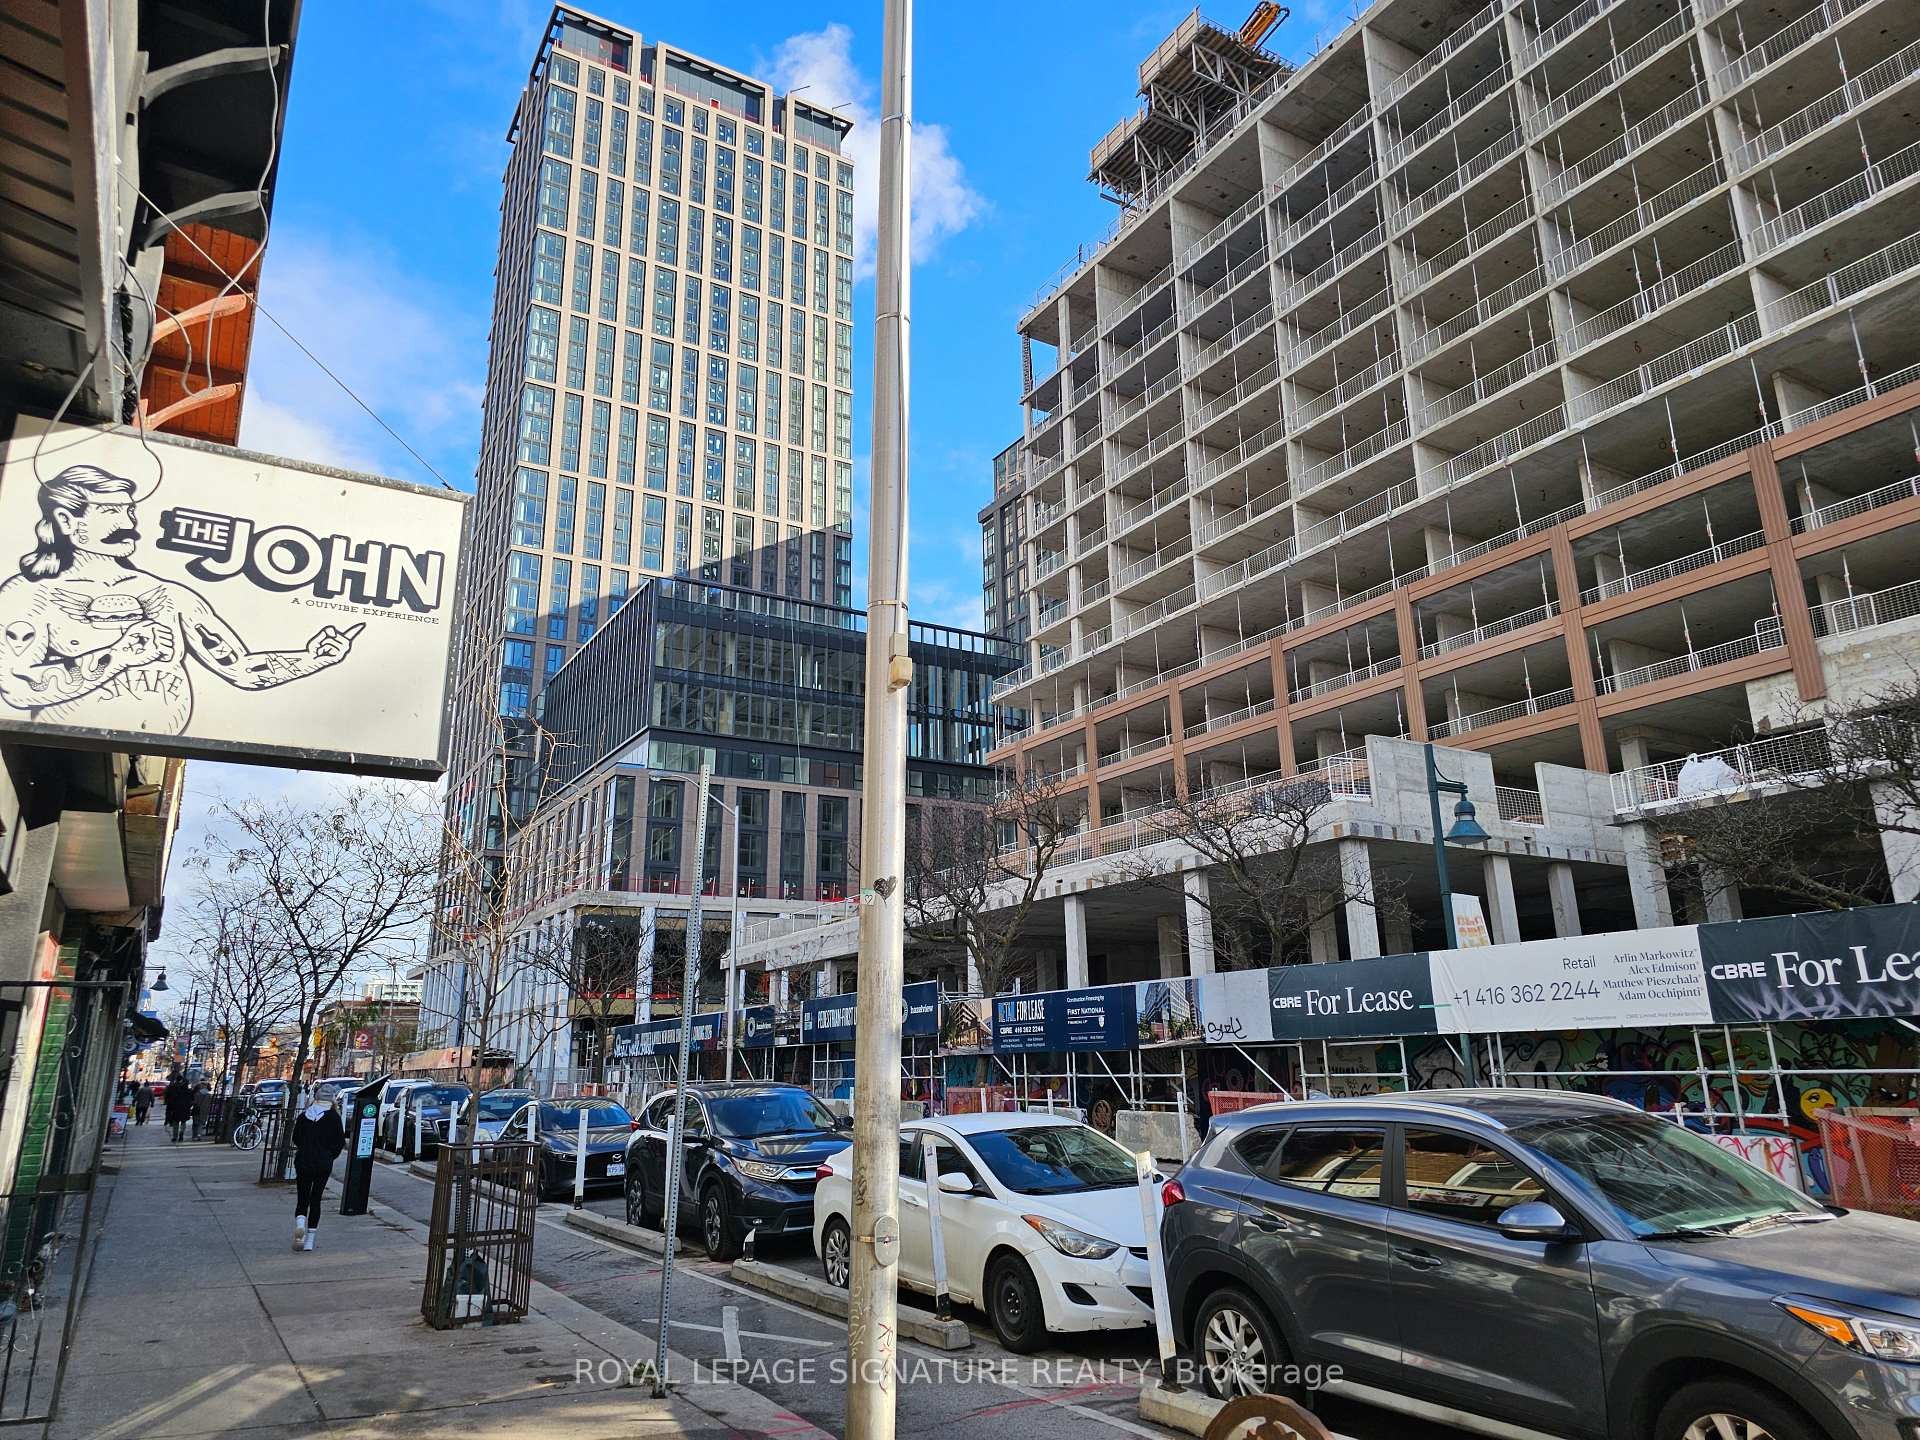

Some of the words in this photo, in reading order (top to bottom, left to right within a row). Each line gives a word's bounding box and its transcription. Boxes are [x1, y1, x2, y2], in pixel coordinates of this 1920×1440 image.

[173, 516, 230, 544] THE
[188, 518, 445, 612] JOHN
[291, 597, 301, 605] A
[305, 599, 359, 613] OUIVIBE
[362, 607, 440, 624] EXPERIENCE
[97, 669, 183, 705] SNAKE
[1563, 955, 1596, 970] Retail
[1614, 953, 1637, 963] Arlin
[1640, 949, 1694, 961] Markowitz
[1629, 964, 1650, 975] Alex
[1652, 962, 1696, 973] Edmison
[1603, 978, 1644, 989] Matthew
[1646, 974, 1699, 986] Pieszchala
[1711, 961, 1767, 980] CBRE
[1771, 951, 1843, 989] For
[1273, 996, 1302, 1009] CBRE
[1304, 989, 1341, 1016] For
[1345, 986, 1414, 1014] Lease
[1453, 988, 1470, 1006] +1
[1476, 986, 1505, 1005] 416
[1510, 983, 1545, 1003] 362
[1550, 979, 1600, 1001] 2244
[1618, 990, 1646, 1001] Adam
[1648, 987, 1702, 1000] Occhipinti
[1016, 1001, 1028, 1021] FOR
[1028, 999, 1045, 1020] LEASE
